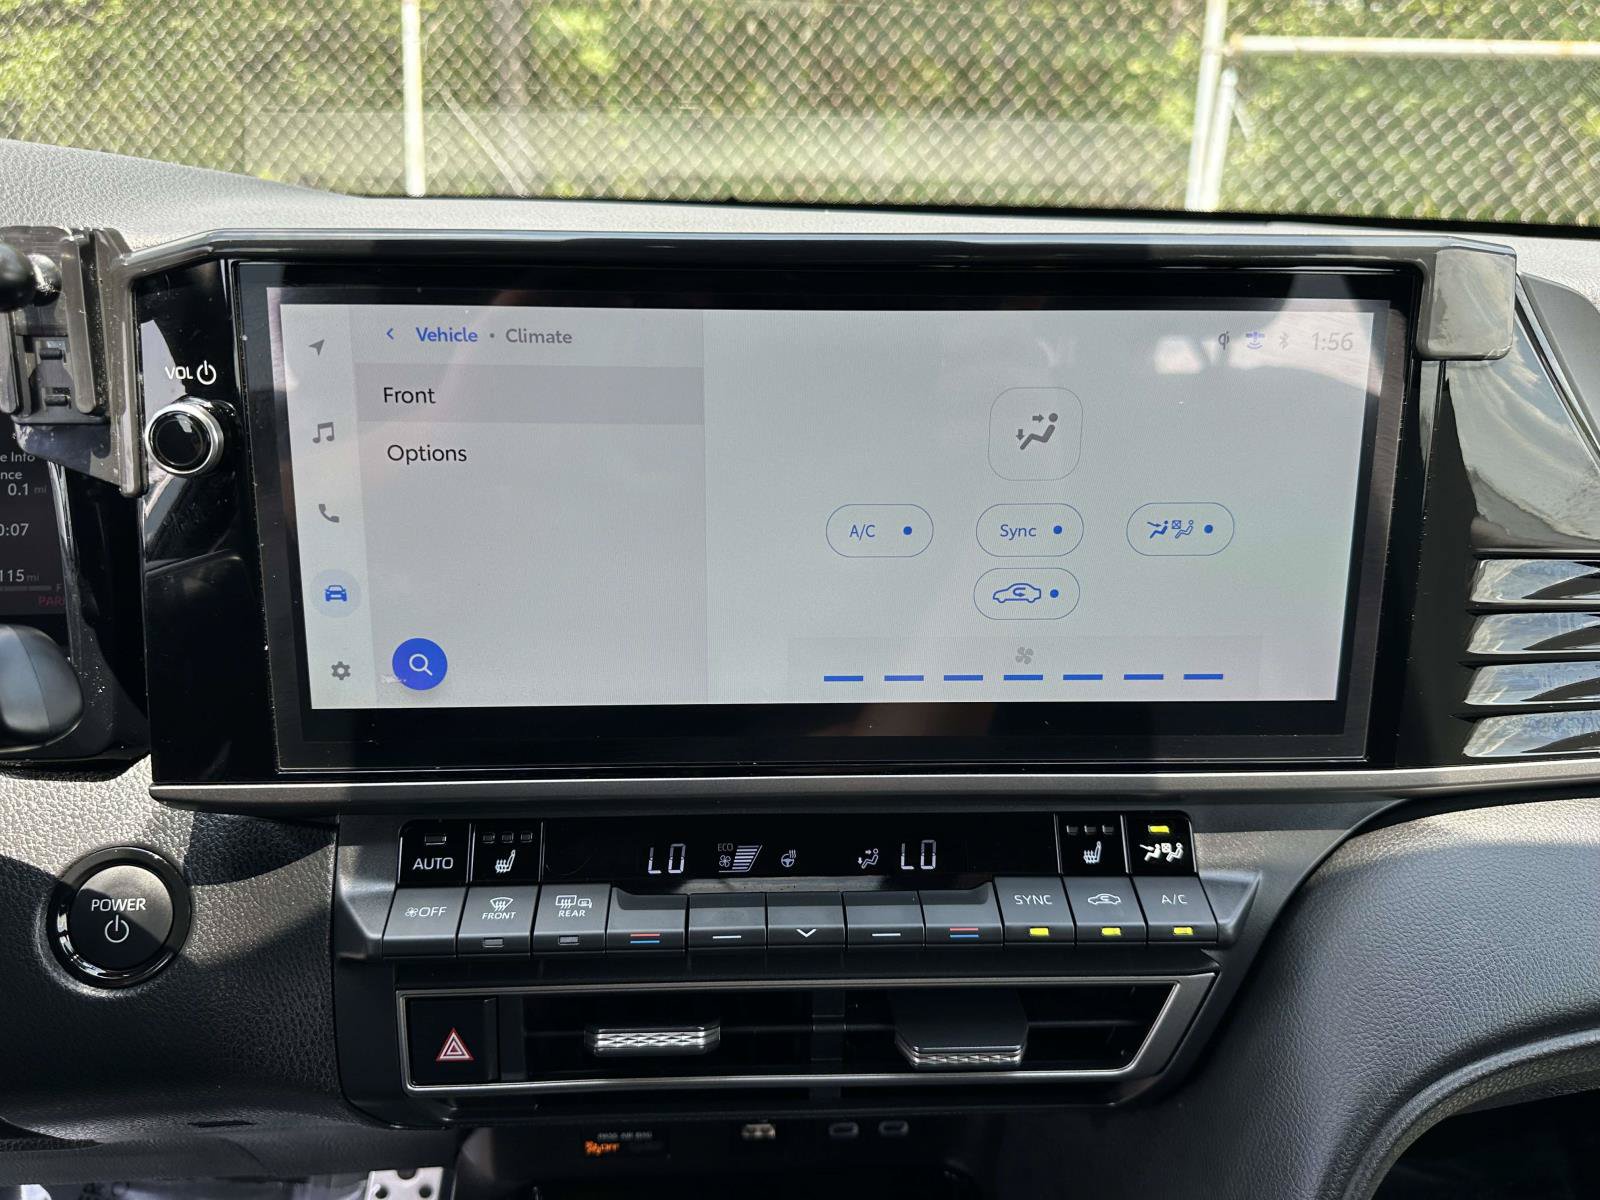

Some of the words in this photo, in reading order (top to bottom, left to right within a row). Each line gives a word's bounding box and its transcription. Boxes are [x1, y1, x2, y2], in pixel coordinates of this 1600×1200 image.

[416, 326, 478, 343] Vehicle
[505, 328, 573, 344] Climate
[1311, 332, 1354, 351] 1:56
[164, 366, 194, 380] VOL
[383, 387, 436, 404] Front
[387, 444, 468, 465] Options
[7, 482, 29, 496] 0.1
[849, 524, 876, 539] A/C
[1000, 523, 1037, 543] Sync
[412, 856, 454, 871] AUTO
[91, 898, 147, 912] POWER
[1013, 894, 1053, 906] SYNC
[1161, 894, 1188, 906] A/C
[418, 905, 447, 918] OFF
[481, 911, 517, 921] FRONT
[558, 908, 586, 919] REAR
